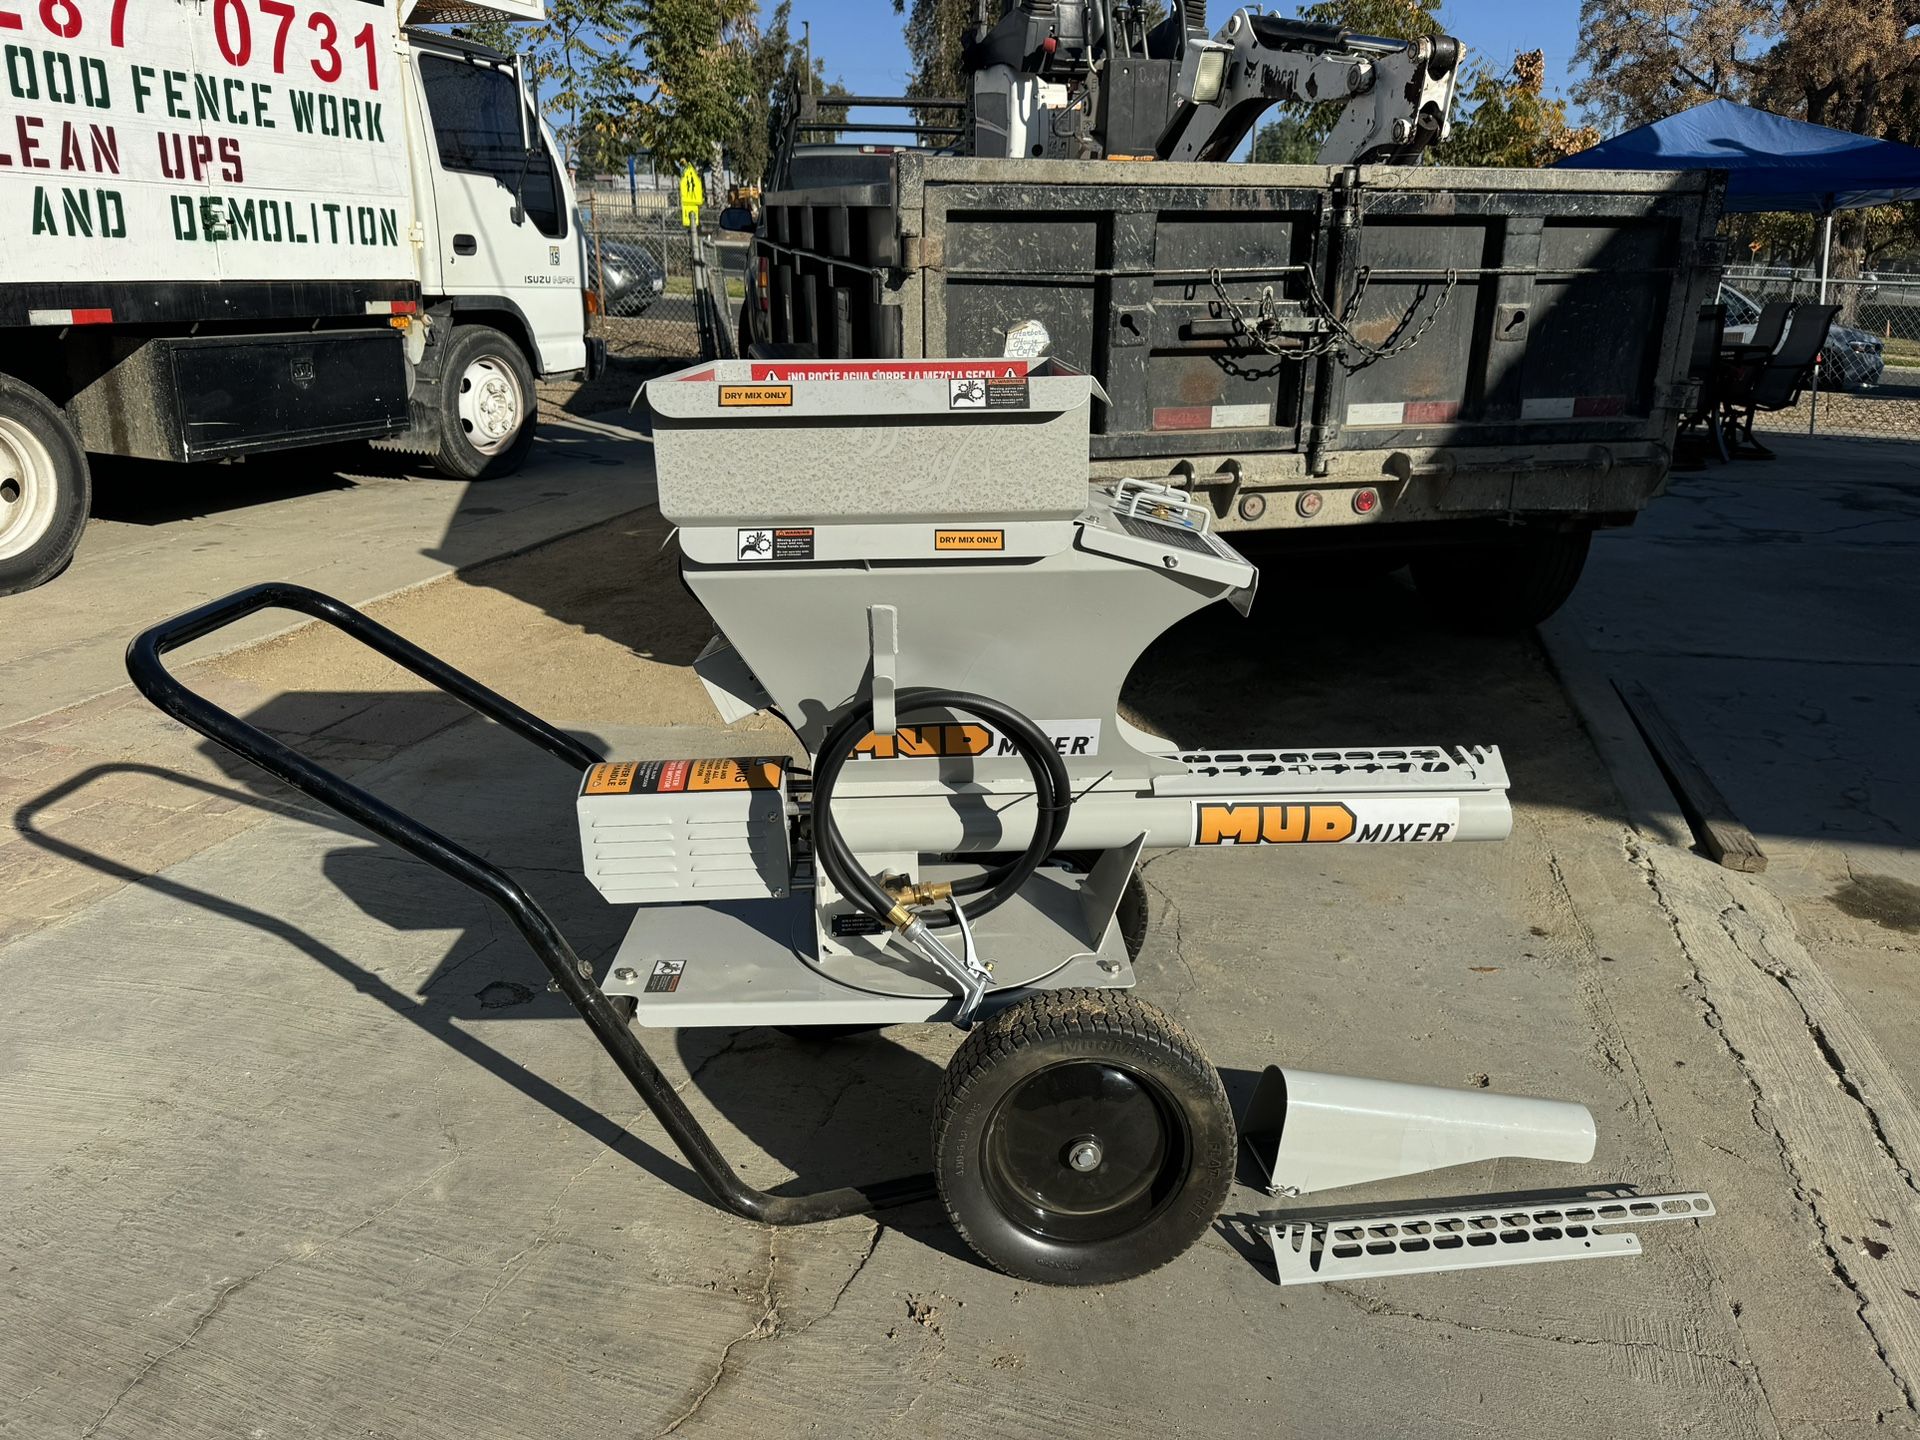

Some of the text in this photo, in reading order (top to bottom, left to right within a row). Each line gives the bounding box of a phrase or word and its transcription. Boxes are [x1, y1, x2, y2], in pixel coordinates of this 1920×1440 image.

[213, 0, 379, 91] 0731
[131, 64, 276, 128] FENCE
[289, 89, 385, 143] WORK
[157, 131, 243, 182] UPS
[32, 186, 398, 246] AND DEMOLITION
[524, 275, 551, 284] ISUZU
[724, 391, 787, 400] DRY MIX ONLY
[939, 536, 998, 544] DRY MIX ONLY
[663, 770, 675, 789] MOTOR
[1194, 801, 1455, 846] MUD MIXER
